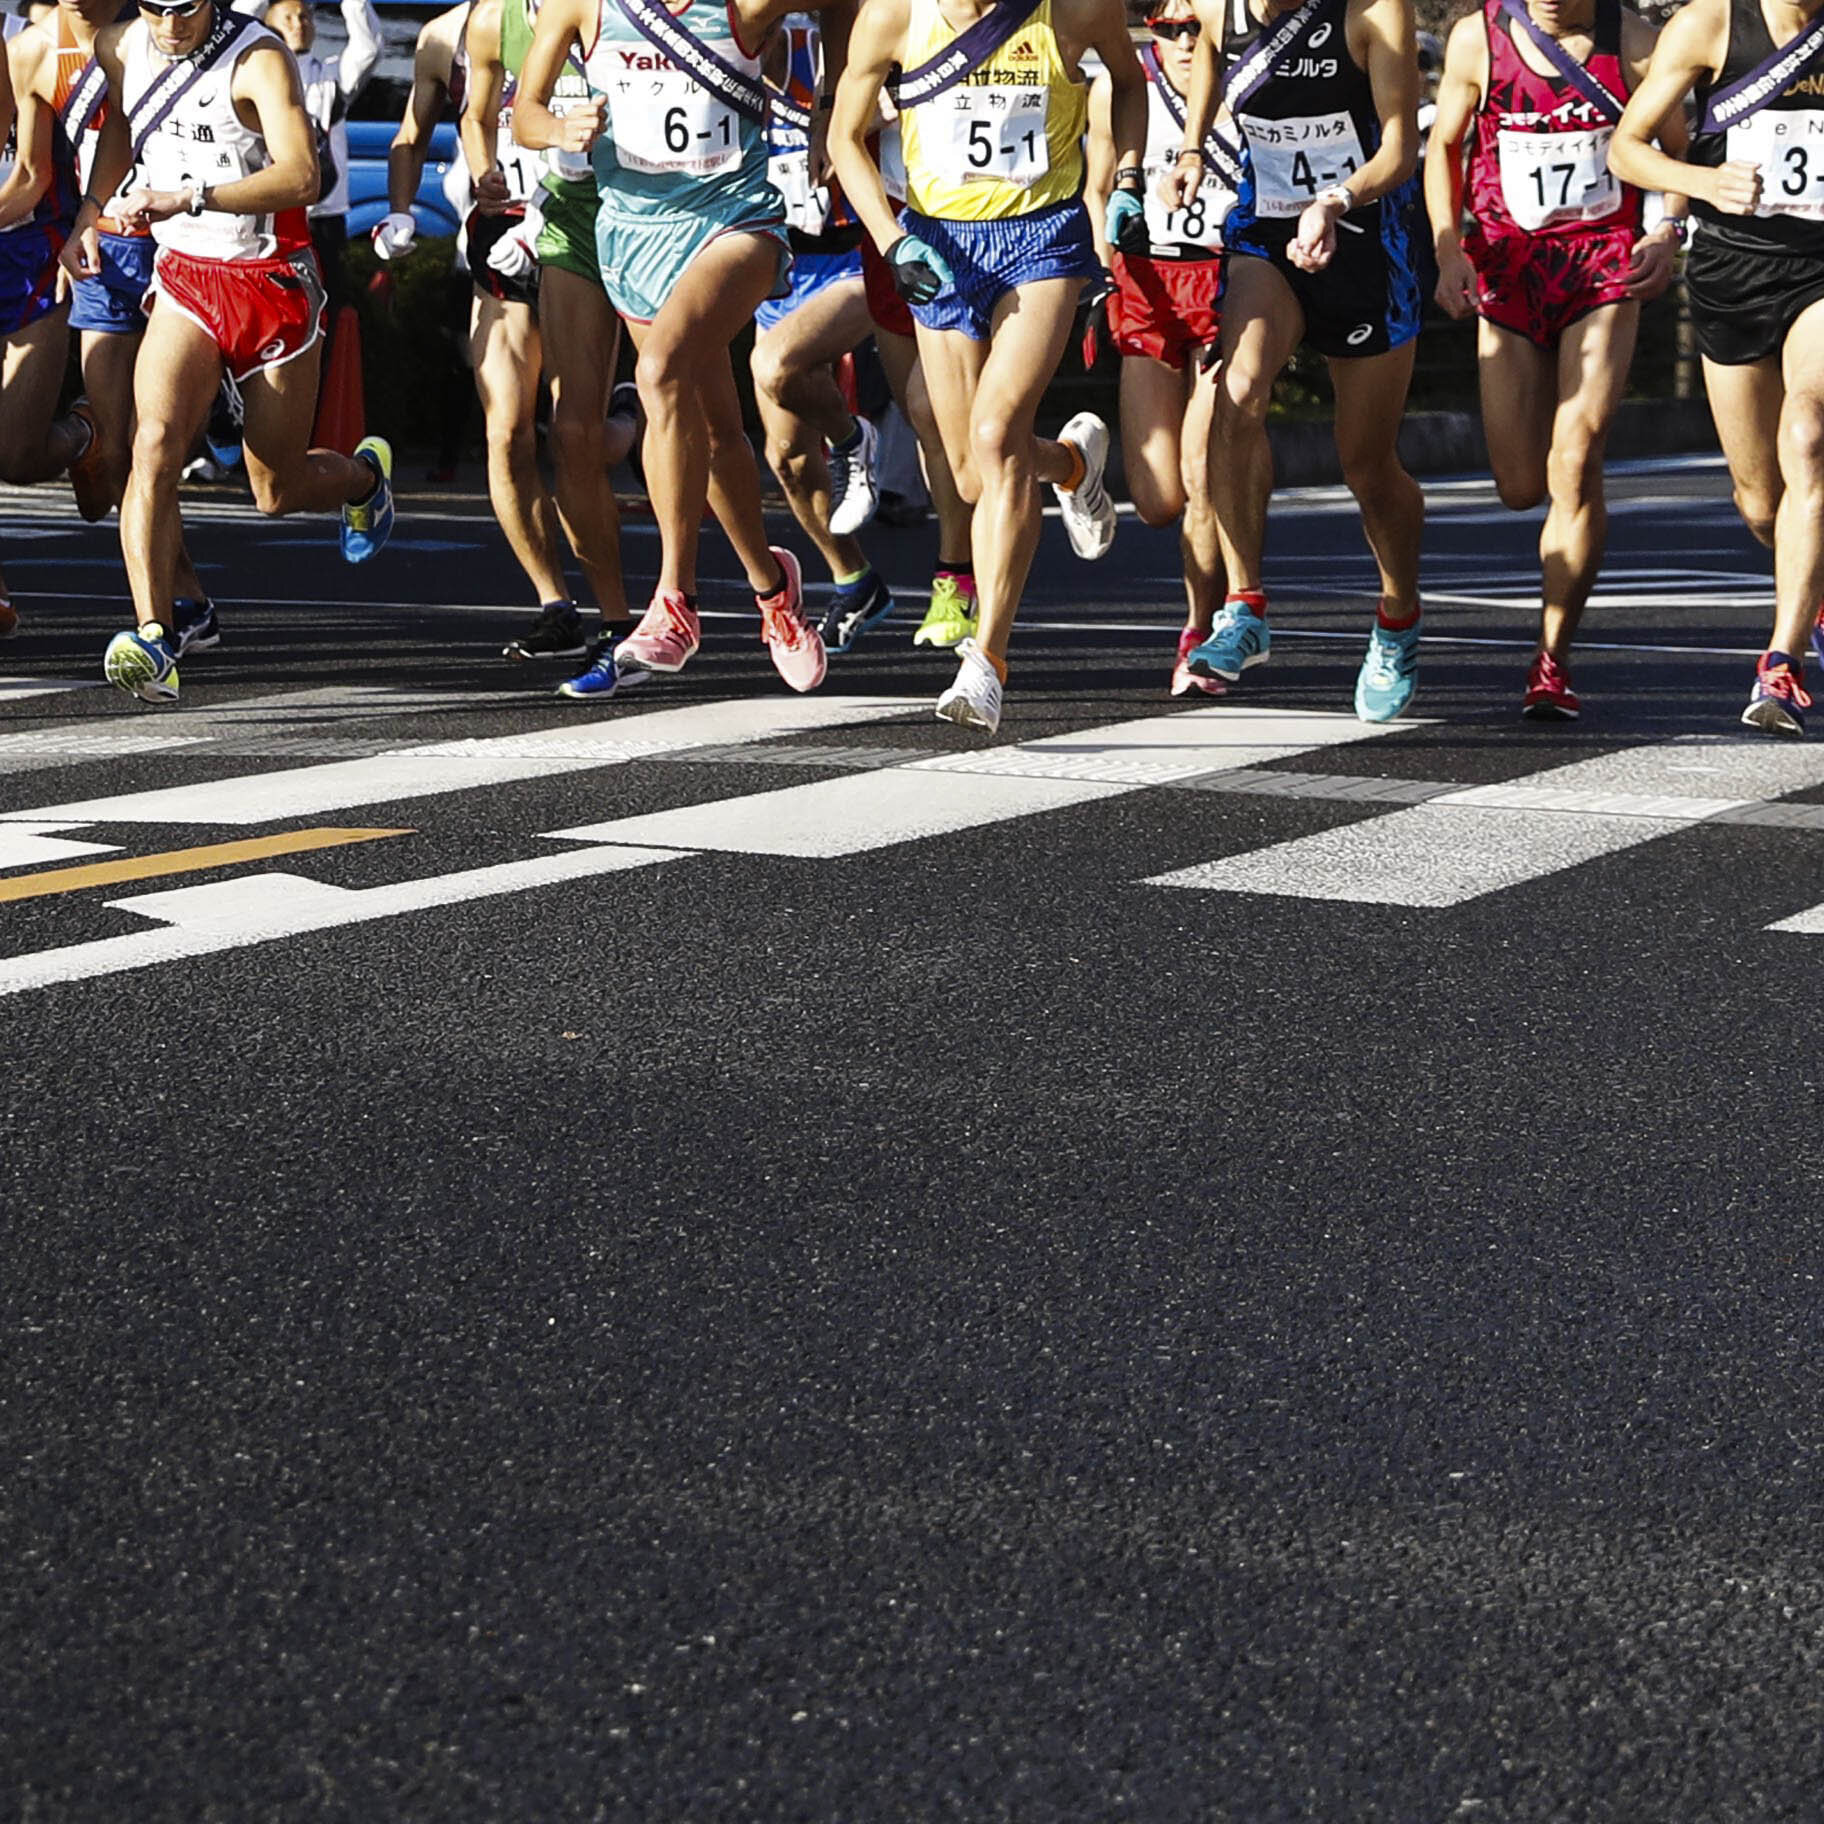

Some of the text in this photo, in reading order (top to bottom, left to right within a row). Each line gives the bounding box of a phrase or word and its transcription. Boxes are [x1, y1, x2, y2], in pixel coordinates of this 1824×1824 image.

[619, 51, 682, 72] Yak
[664, 107, 731, 154] 6-1
[967, 120, 1035, 168] 5-1
[1246, 119, 1348, 143] コニカミノルタ
[1292, 151, 1357, 194] 4-1
[1529, 163, 1614, 207] 17-1
